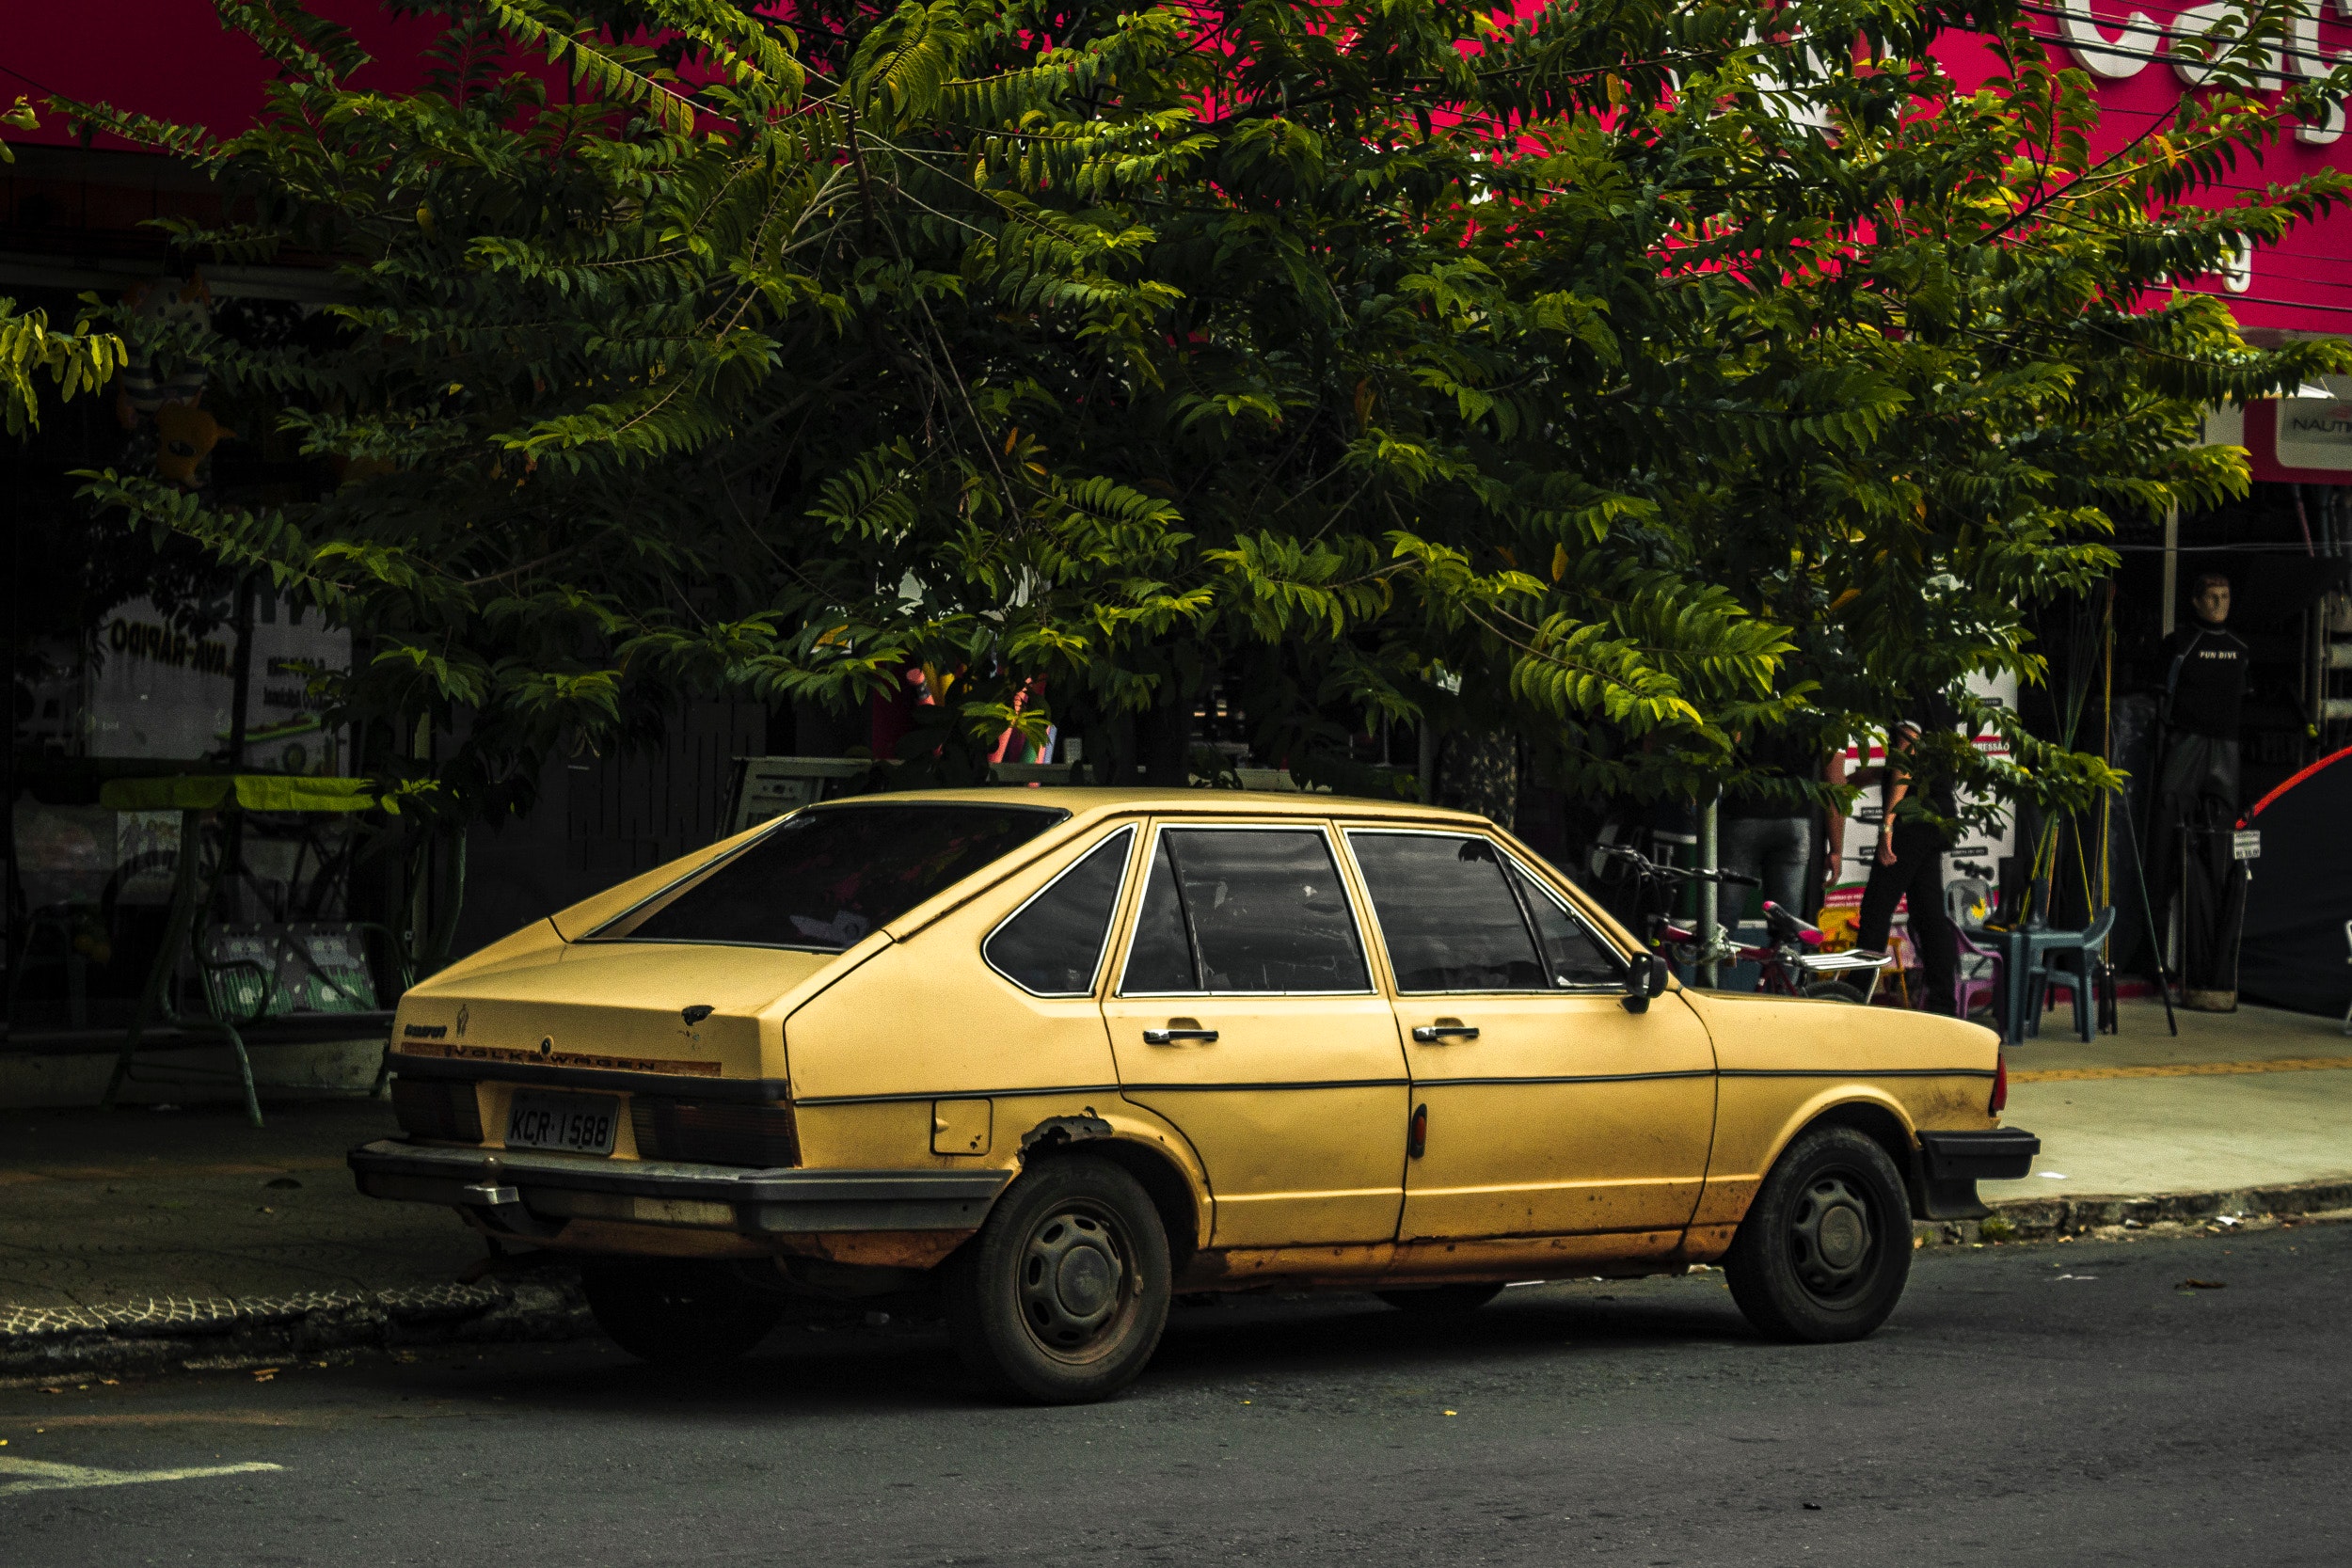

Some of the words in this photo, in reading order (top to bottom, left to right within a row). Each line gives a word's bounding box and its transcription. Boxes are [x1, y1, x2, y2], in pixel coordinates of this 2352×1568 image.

[2293, 419, 2352, 433] NAUTI
[2218, 650, 2237, 659] DIVE
[455, 1045, 656, 1070] VOLKSWAGEN
